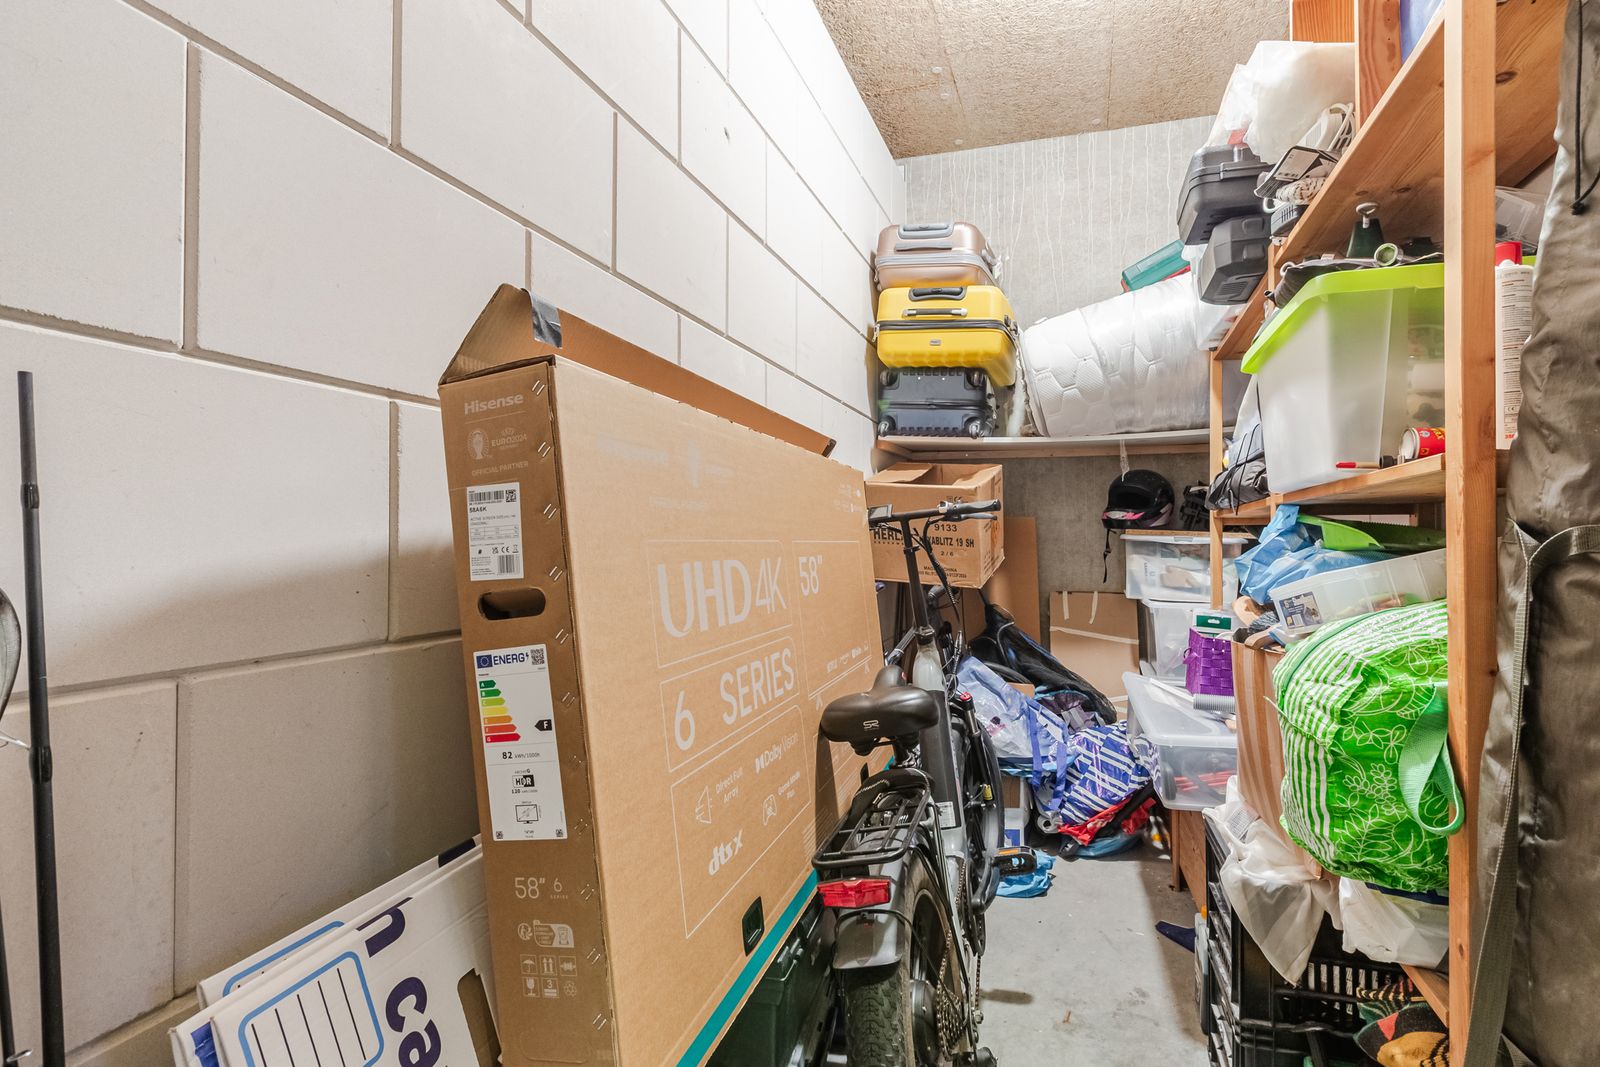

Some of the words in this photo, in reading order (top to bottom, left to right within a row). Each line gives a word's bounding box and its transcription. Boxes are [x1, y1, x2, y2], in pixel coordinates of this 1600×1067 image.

[464, 393, 524, 415] Hisense
[471, 466, 499, 477] OFFICIAL
[500, 460, 529, 472] PARTNER
[934, 523, 957, 532] 9133
[956, 538, 963, 547] 19
[966, 538, 975, 548] SH
[674, 690, 696, 751] 6
[719, 647, 795, 725] SERIES
[502, 751, 513, 759] 82
[515, 777, 532, 786] HDR
[553, 878, 563, 892] 6
